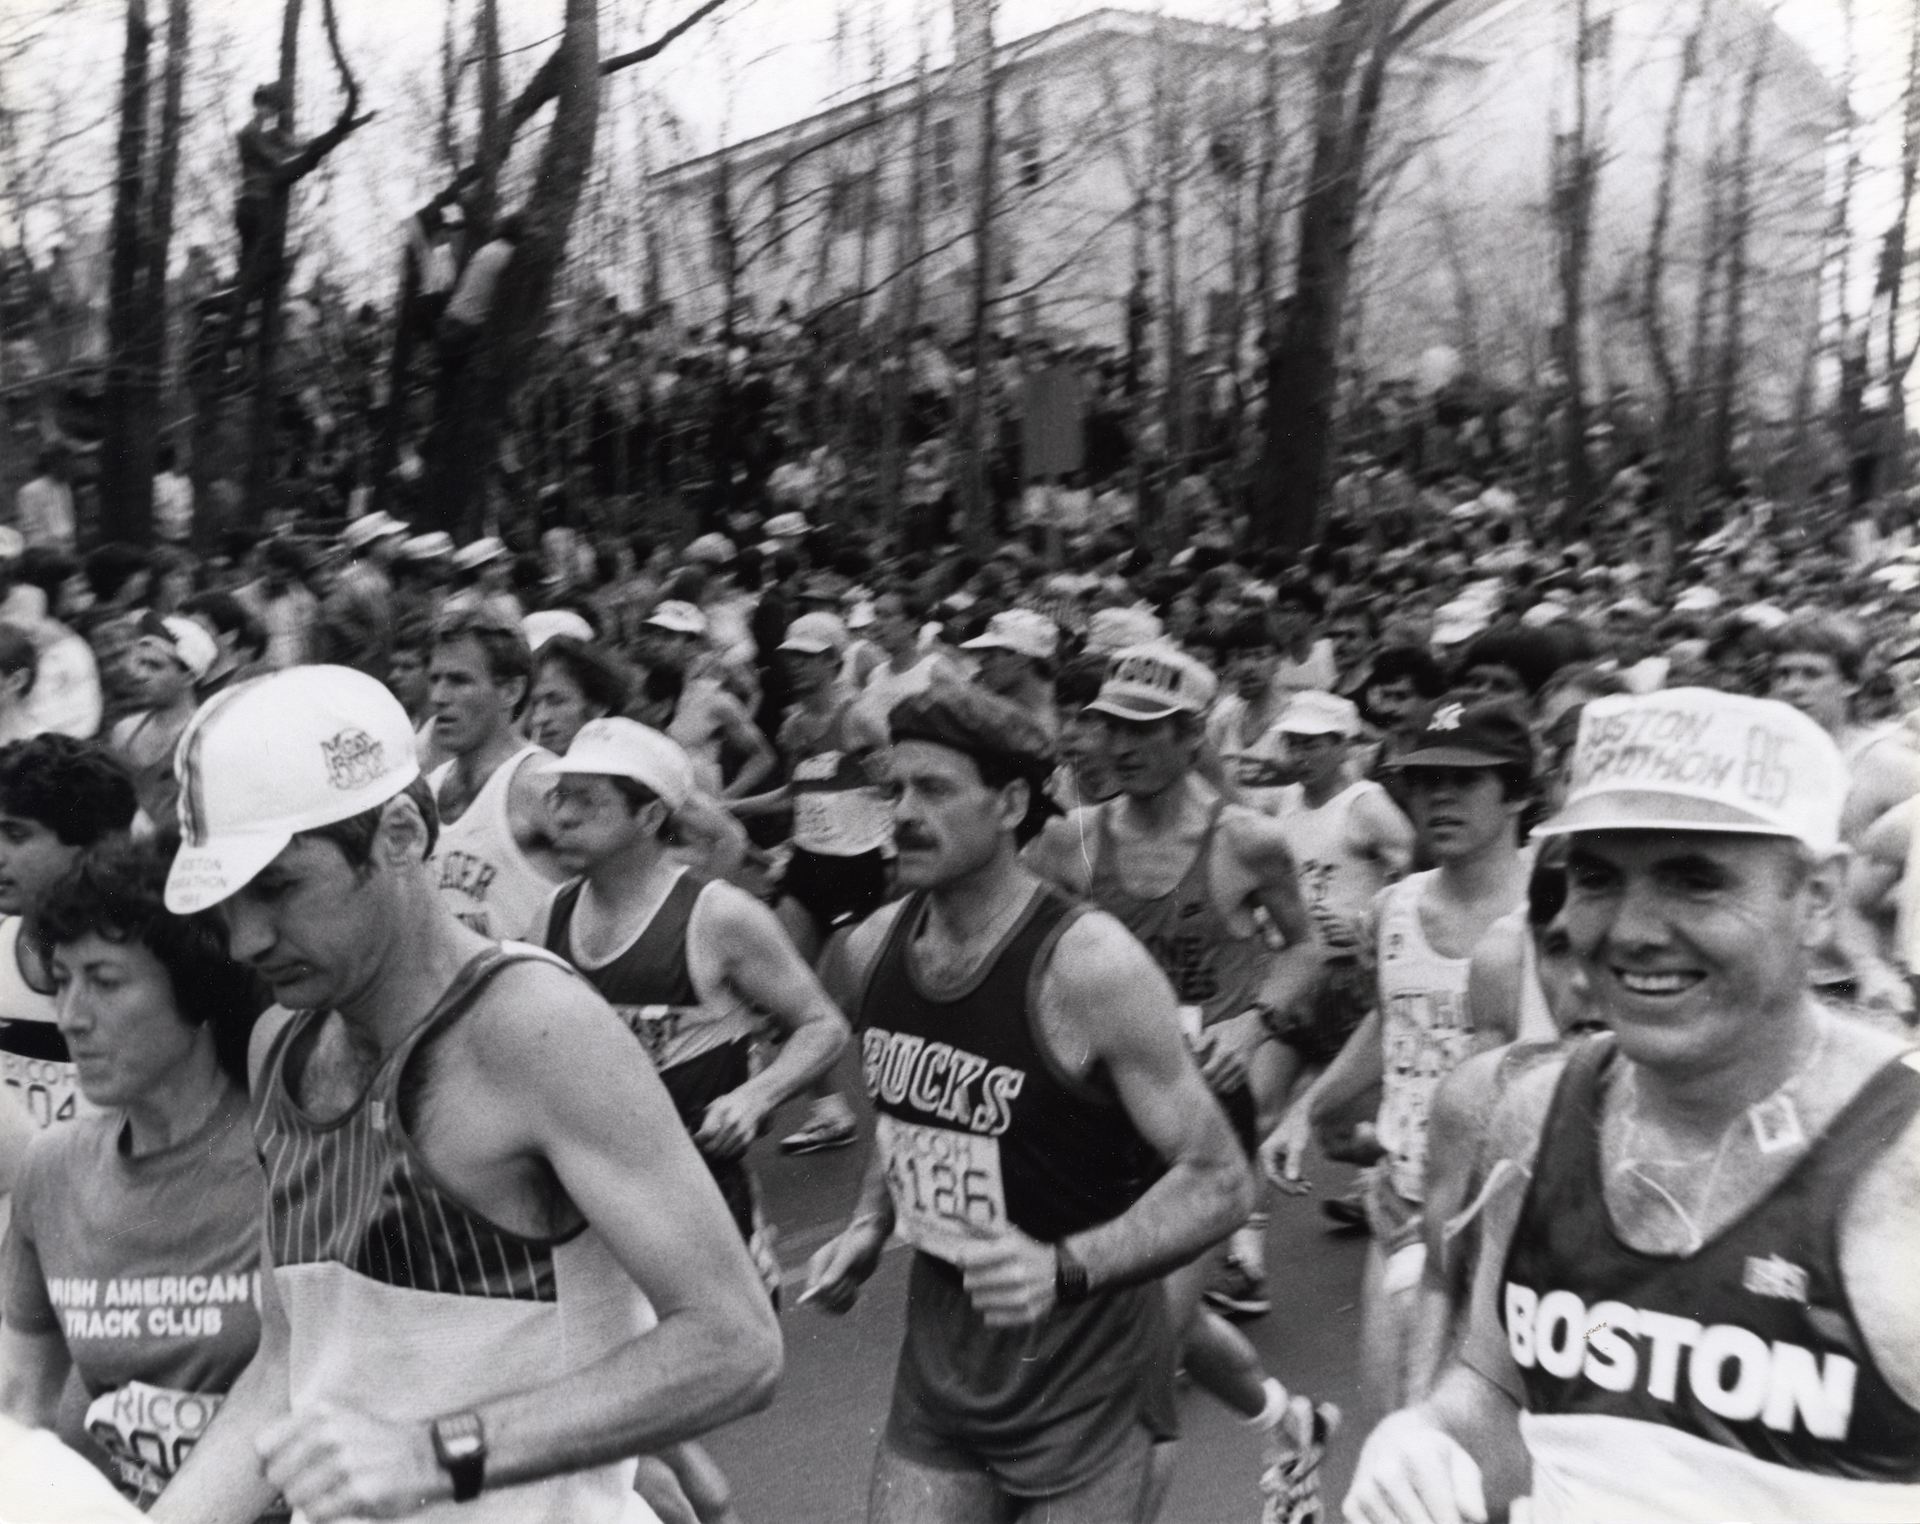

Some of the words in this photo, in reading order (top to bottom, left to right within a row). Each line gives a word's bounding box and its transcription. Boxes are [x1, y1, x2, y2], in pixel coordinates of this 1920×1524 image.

[863, 1027, 1026, 1135] BUCKS
[104, 1272, 249, 1308] AMERICAN
[64, 1308, 143, 1339] TRACK
[148, 1306, 223, 1337] CLUB
[1504, 1279, 1858, 1442] BOSTON
[112, 1390, 223, 1432] RICO
